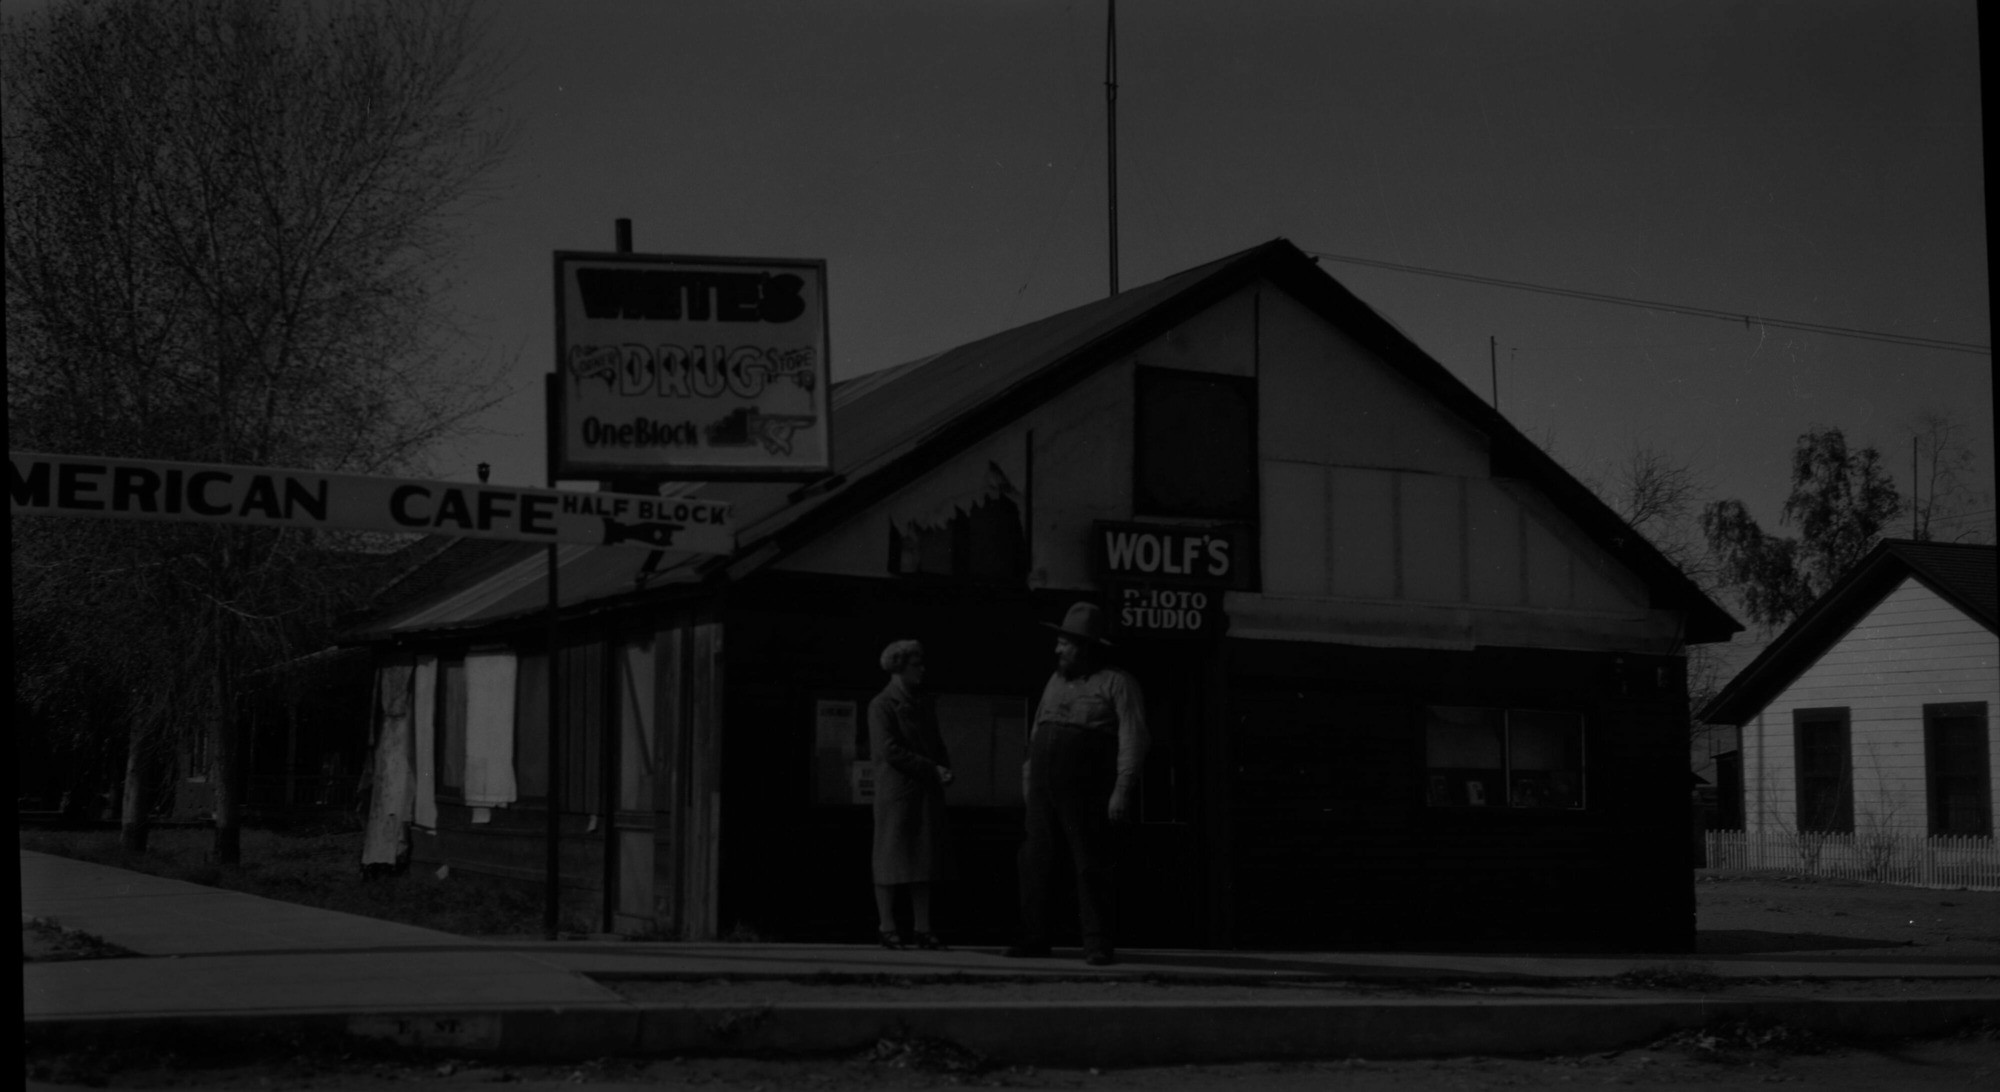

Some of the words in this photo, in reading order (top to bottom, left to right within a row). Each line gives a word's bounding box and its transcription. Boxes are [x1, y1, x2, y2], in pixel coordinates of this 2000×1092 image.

[620, 343, 767, 398] DRUG
[389, 485, 558, 535] CAFE
[563, 496, 629, 517] HALF
[639, 501, 726, 525] BLOCK
[1105, 531, 1230, 576] WOLF'S
[1121, 608, 1203, 630] STUDIO
